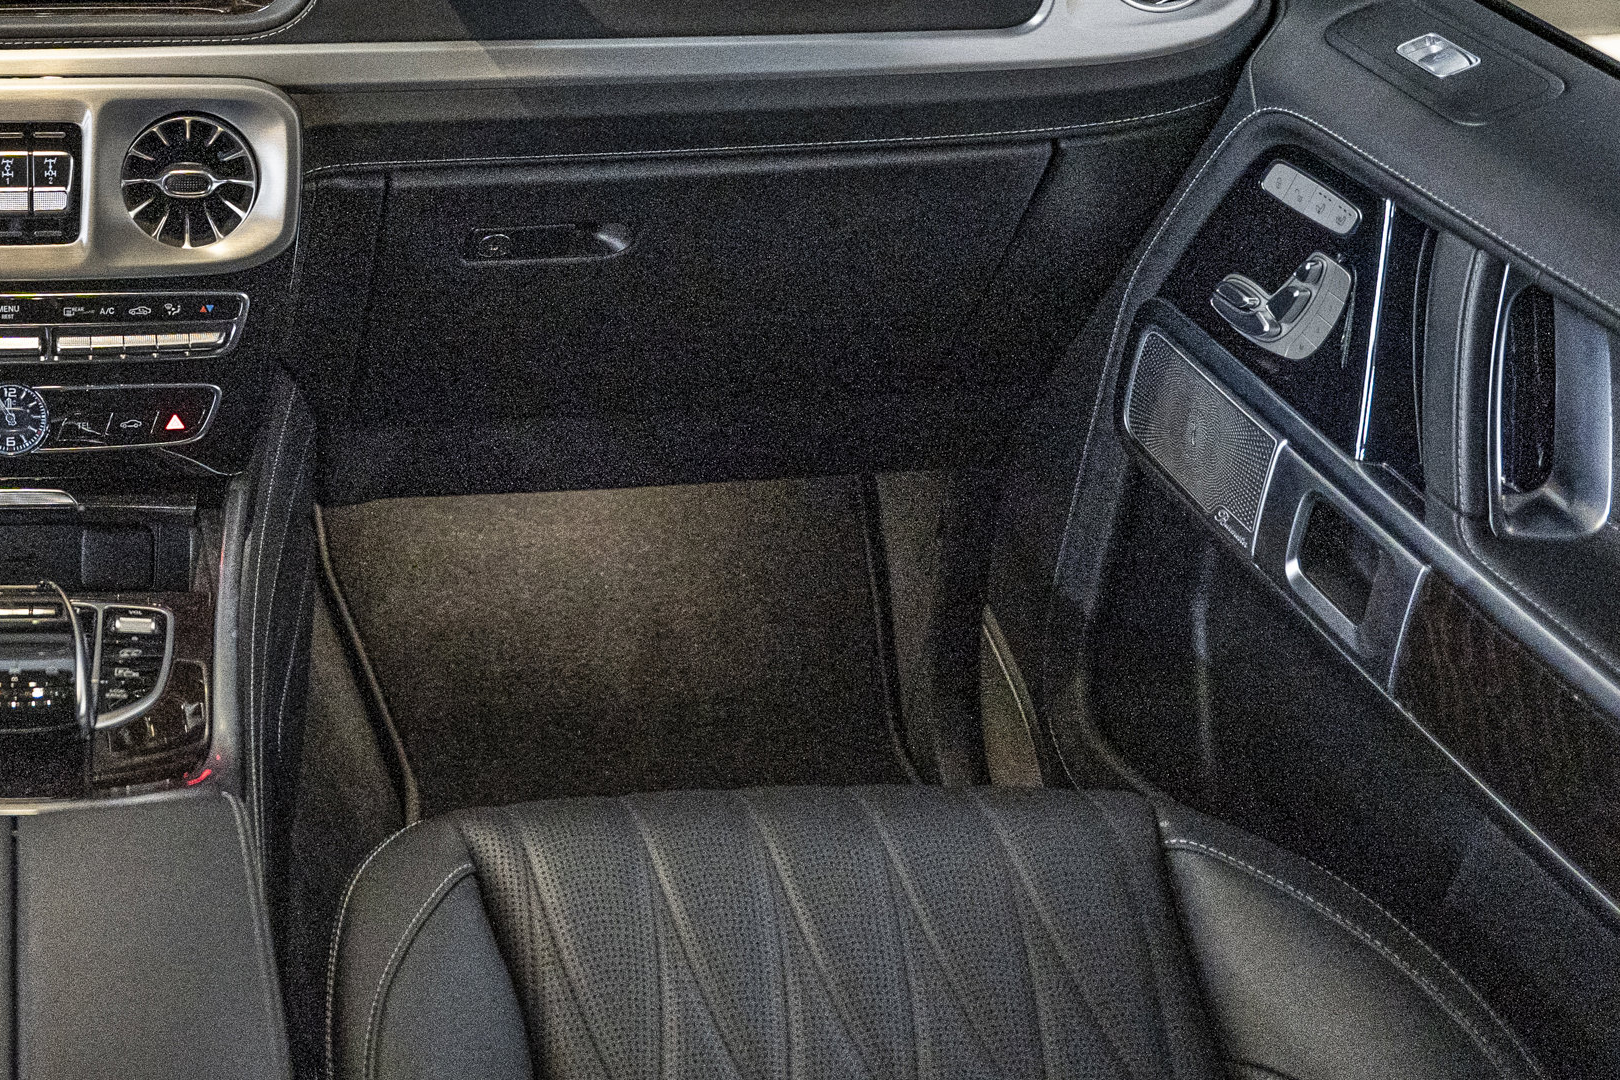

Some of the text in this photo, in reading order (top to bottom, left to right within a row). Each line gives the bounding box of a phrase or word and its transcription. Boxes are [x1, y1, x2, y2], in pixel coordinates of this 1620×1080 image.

[48, 177, 54, 185] 2
[100, 307, 115, 315] A/C
[4, 387, 17, 398] 12
[6, 436, 16, 447] 6
